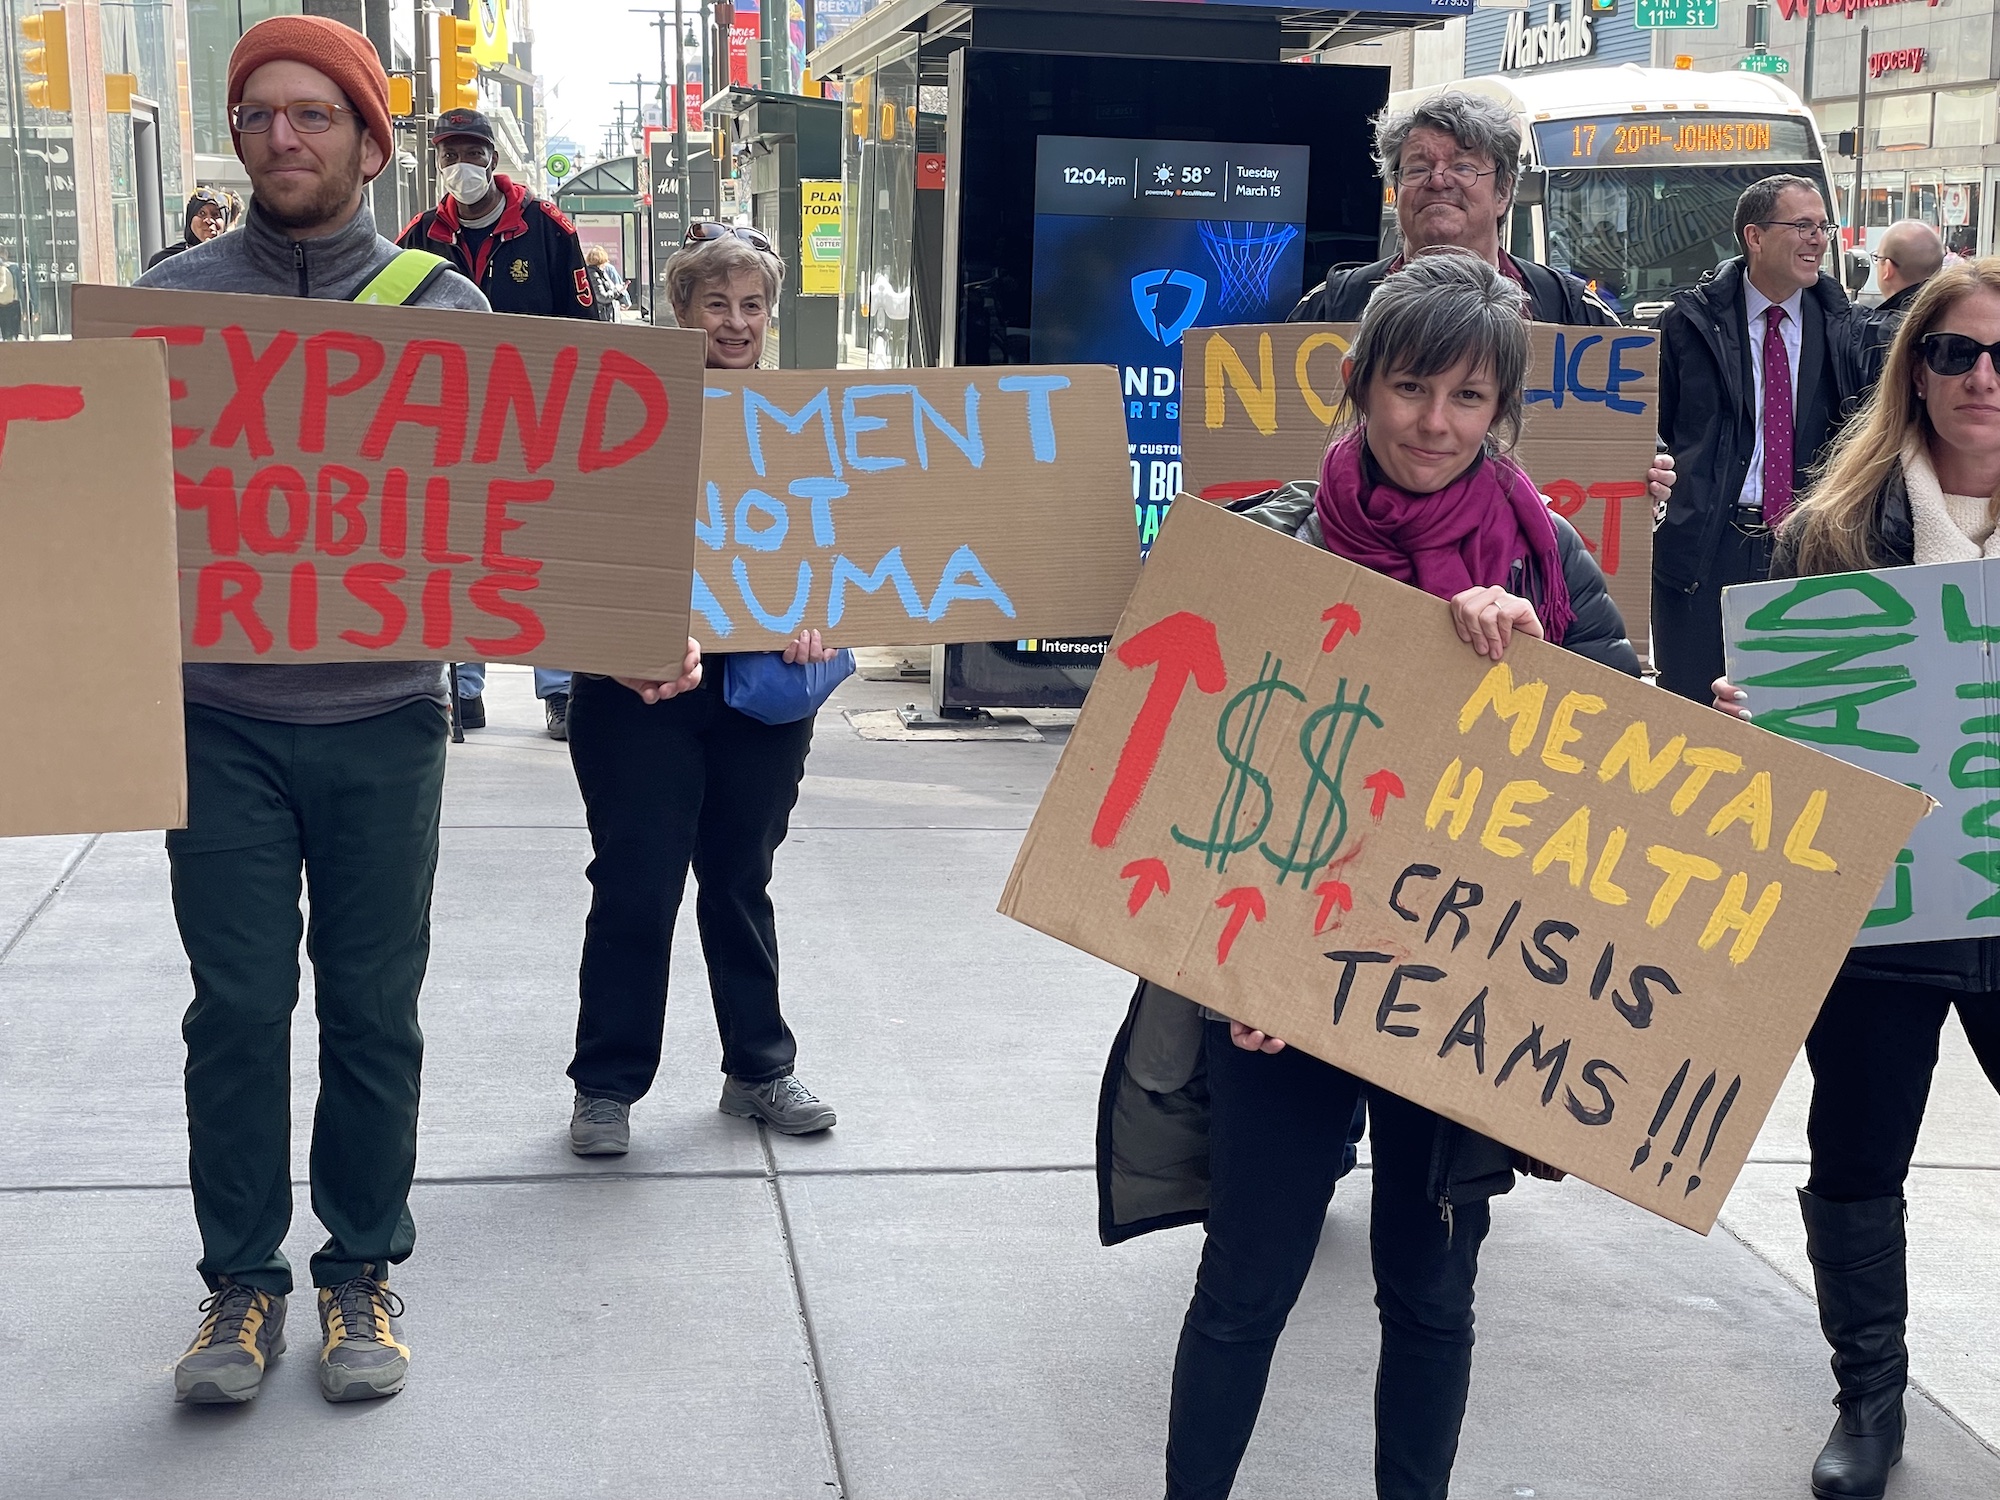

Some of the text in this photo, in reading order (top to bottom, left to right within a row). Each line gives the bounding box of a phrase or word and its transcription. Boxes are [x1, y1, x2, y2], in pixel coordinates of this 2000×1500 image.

[1648, 9, 1705, 25] 11th St
[1499, 0, 1592, 71] Marshalls
[1776, 62, 1787, 72] St
[1869, 48, 1925, 78] grocery
[1572, 123, 1771, 156] 17 20TH-JOHNSTON
[1181, 166, 1211, 184] 58°
[1237, 166, 1279, 180] Tuesday
[1235, 185, 1281, 198] March 15
[803, 205, 842, 215] TODA
[573, 267, 593, 307] 5
[1524, 332, 1657, 415] ICE
[703, 375, 1072, 477] MENT
[178, 560, 547, 656] RISIS
[1042, 639, 1109, 653] Intersecti
[1457, 662, 1838, 873] MENTAL
[1425, 756, 1782, 966] HEALTH
[1390, 863, 1682, 1029] CRISIS
